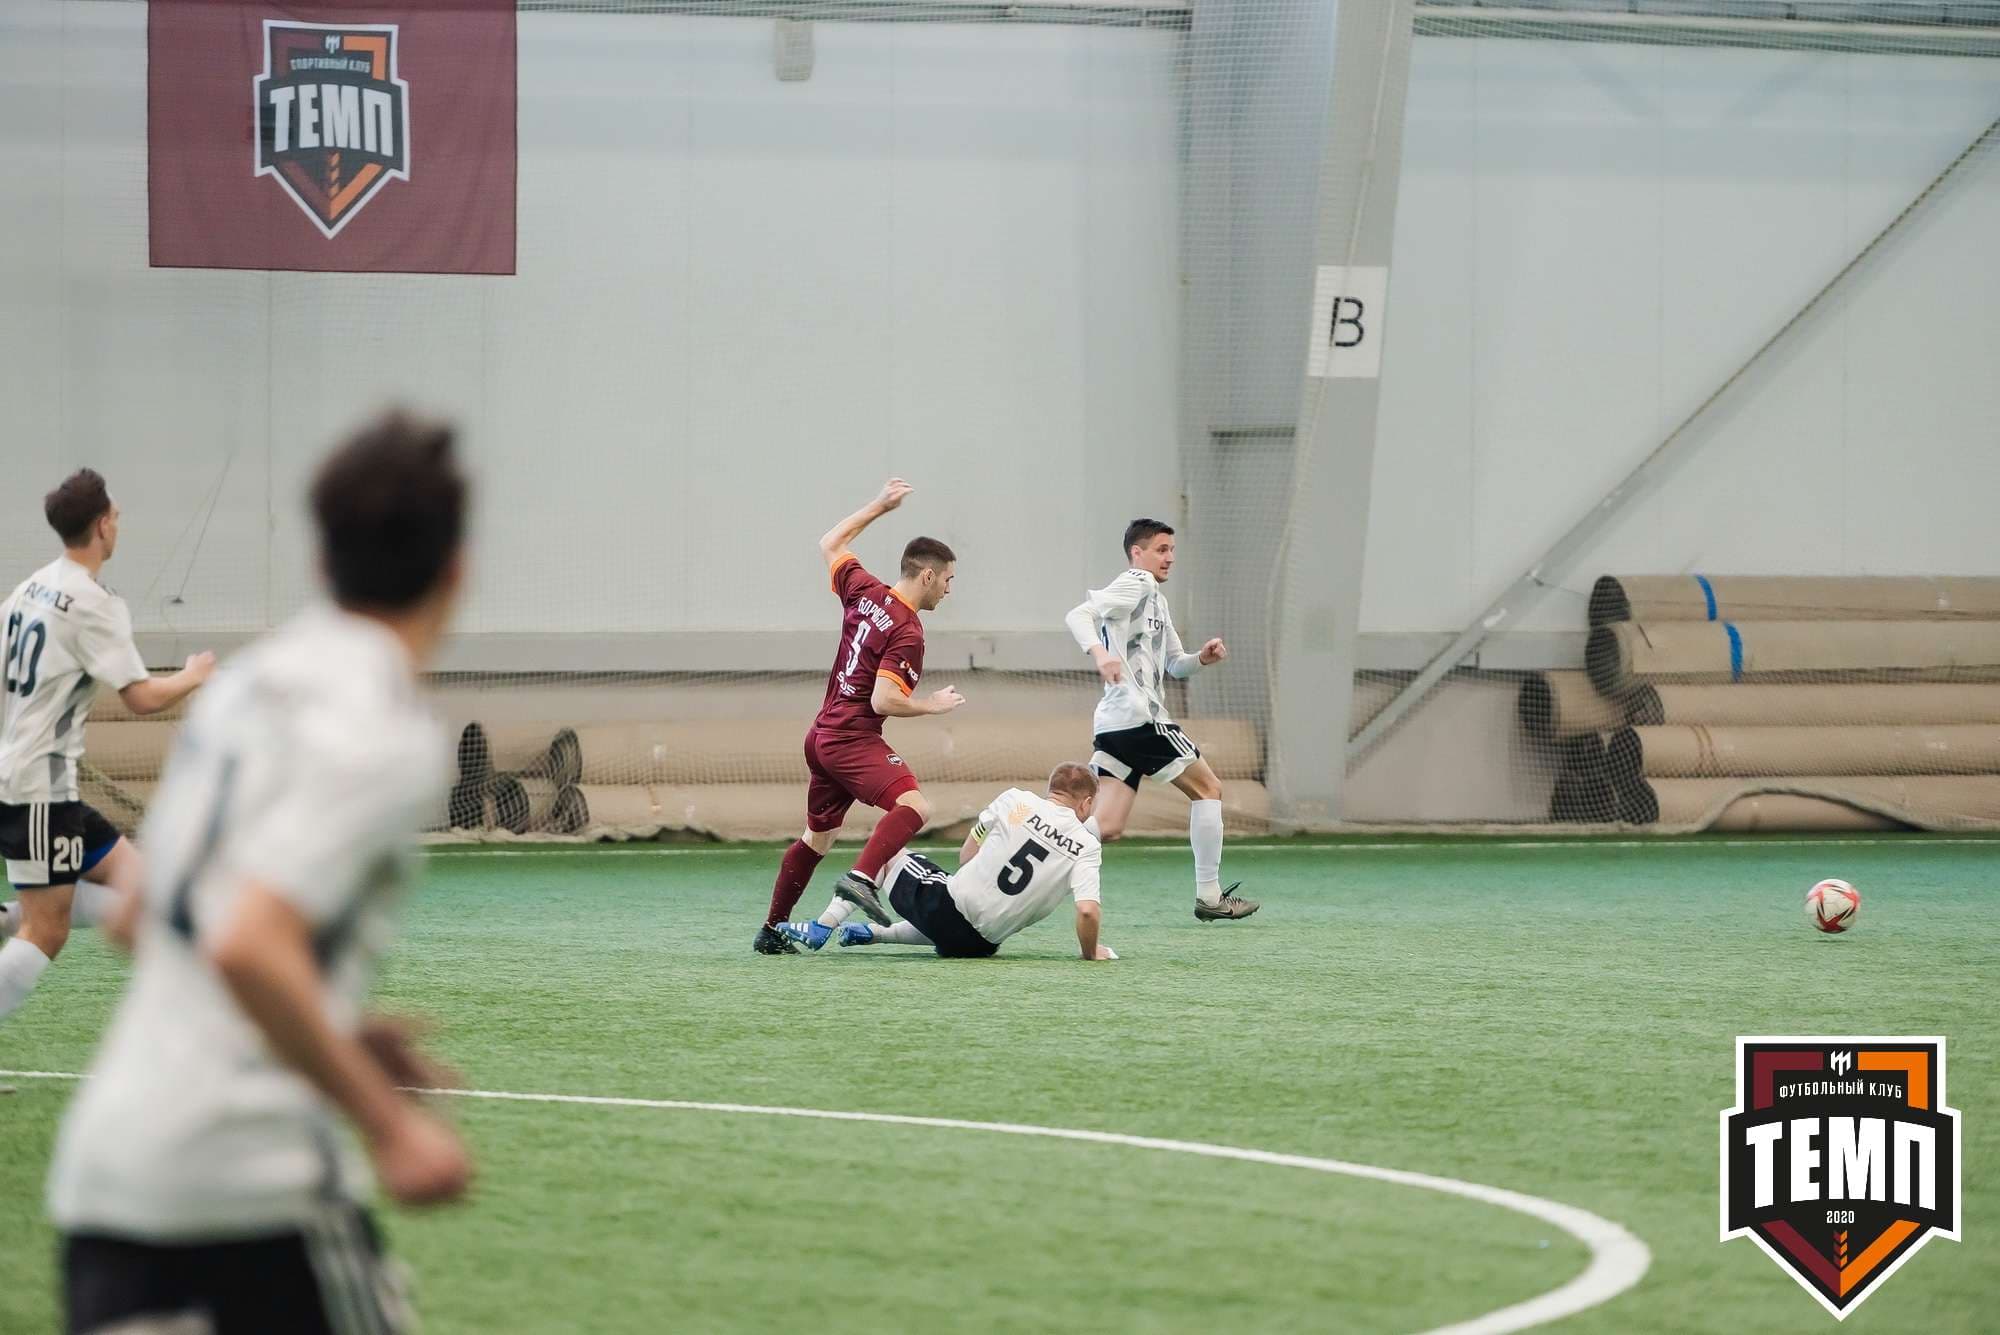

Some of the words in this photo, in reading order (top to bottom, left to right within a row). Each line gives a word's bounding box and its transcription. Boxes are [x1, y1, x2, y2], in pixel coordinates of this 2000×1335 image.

[270, 83, 393, 157] ТЕМП
[53, 836, 84, 872] 20
[1026, 814, 1084, 856] АЛМАЗ
[997, 838, 1050, 896] 5
